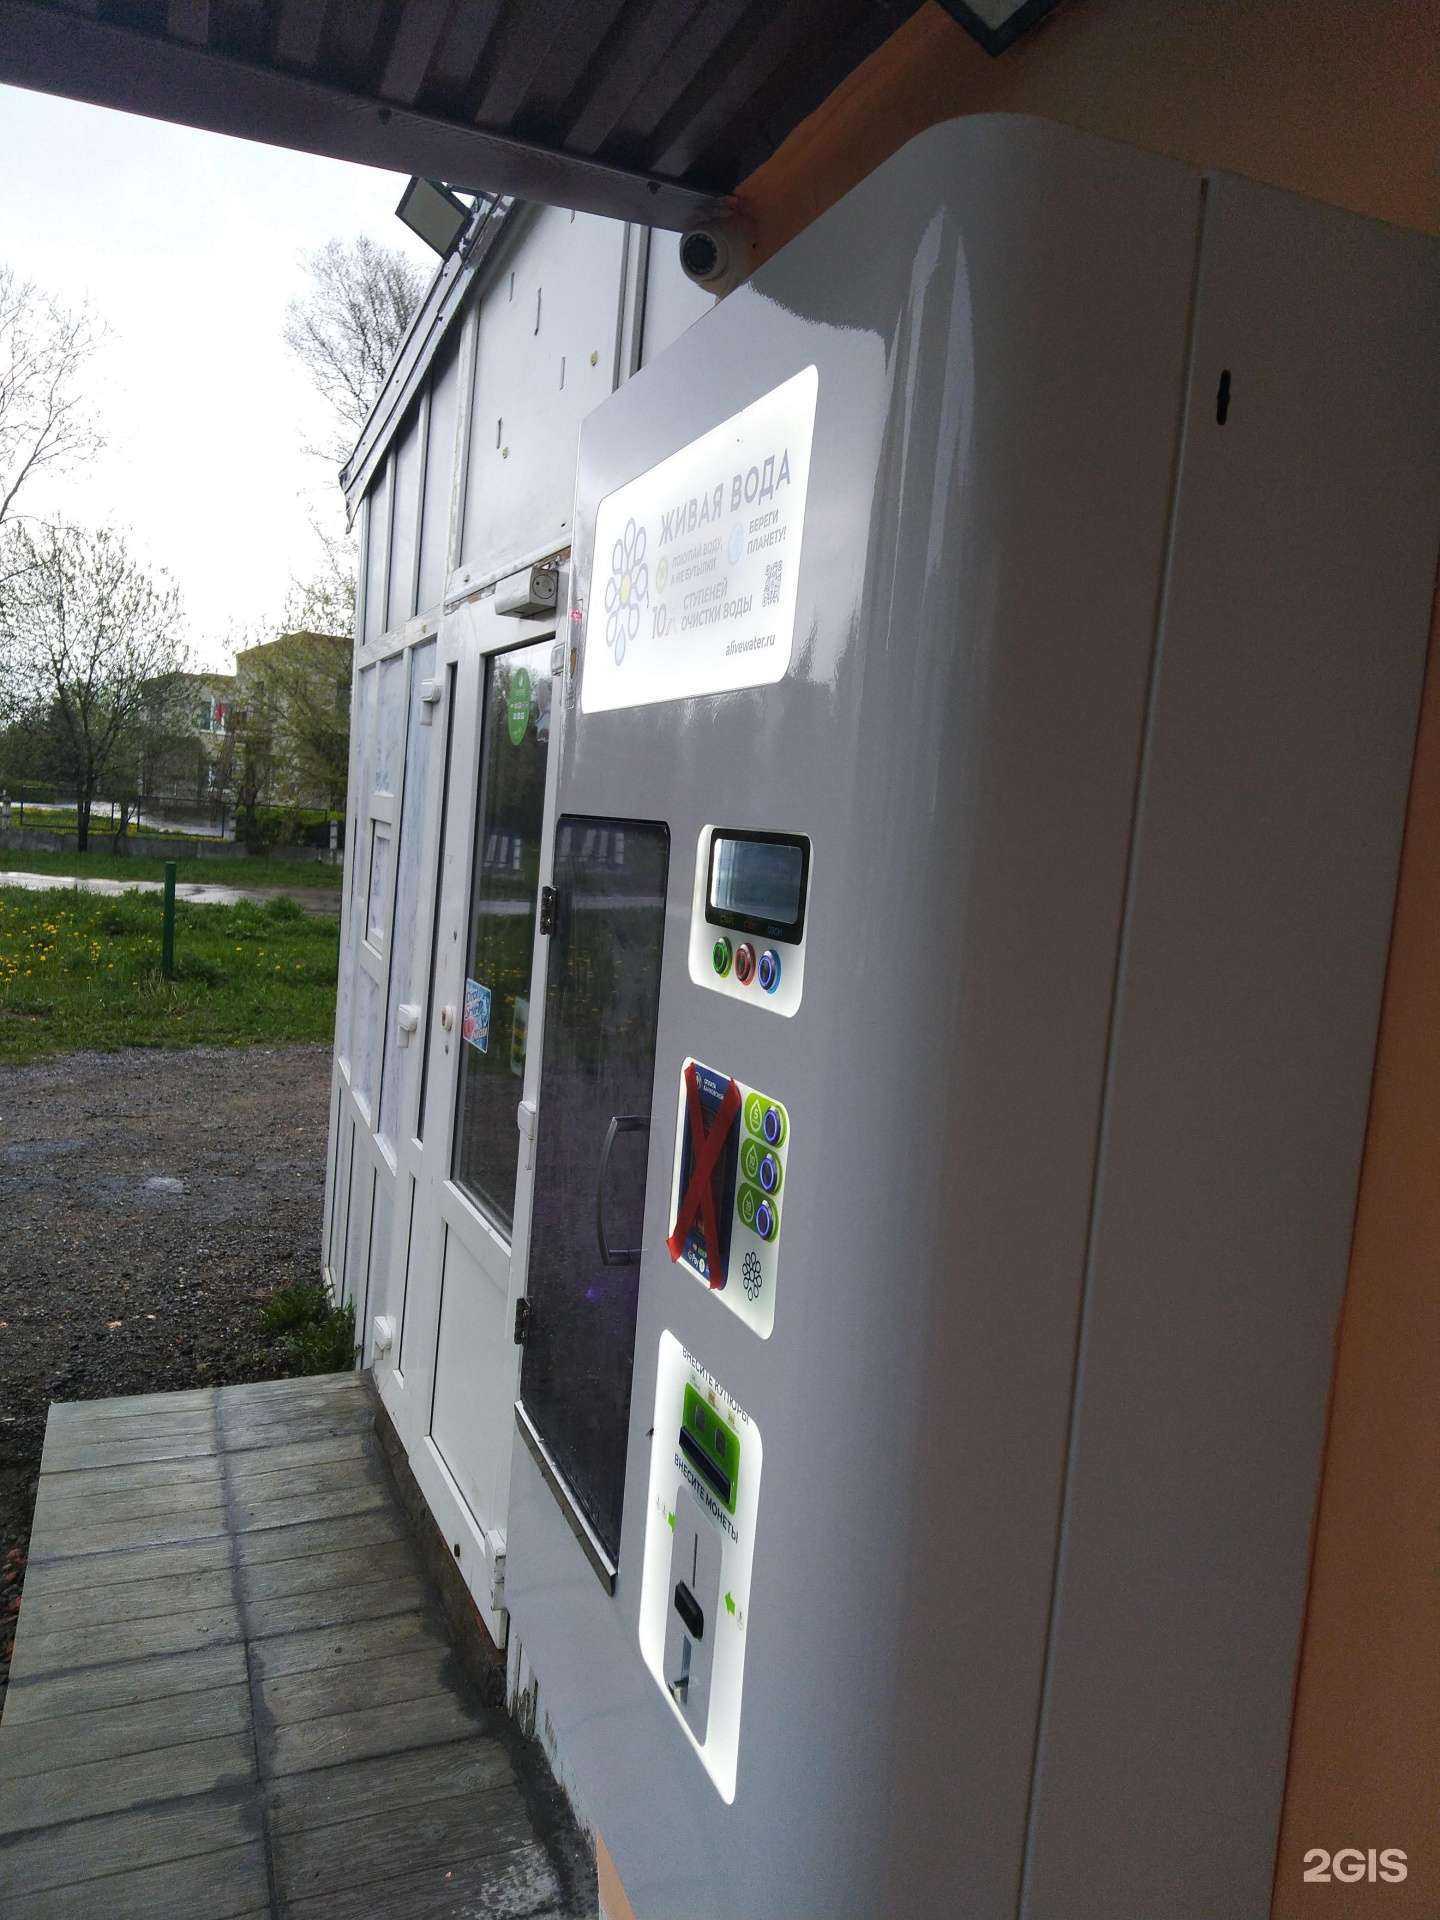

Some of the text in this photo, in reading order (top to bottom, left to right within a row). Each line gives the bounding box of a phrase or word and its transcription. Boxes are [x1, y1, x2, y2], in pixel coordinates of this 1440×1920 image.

[658, 448, 791, 548] ЖИВАЯ ВОДА
[749, 509, 779, 534] БЕРЕГИ
[747, 526, 787, 554] ПЛАНЕТУ!
[683, 575, 728, 611] СТУПЕНЕЙ
[680, 595, 753, 632] ОЧИСТКИ ВОДЫ
[725, 632, 776, 657] alivewater.ru
[682, 1347, 713, 1386] ВНЕСИТЕ
[674, 1453, 739, 1545] ВНЕСИТЕ МОНЕТЫ
